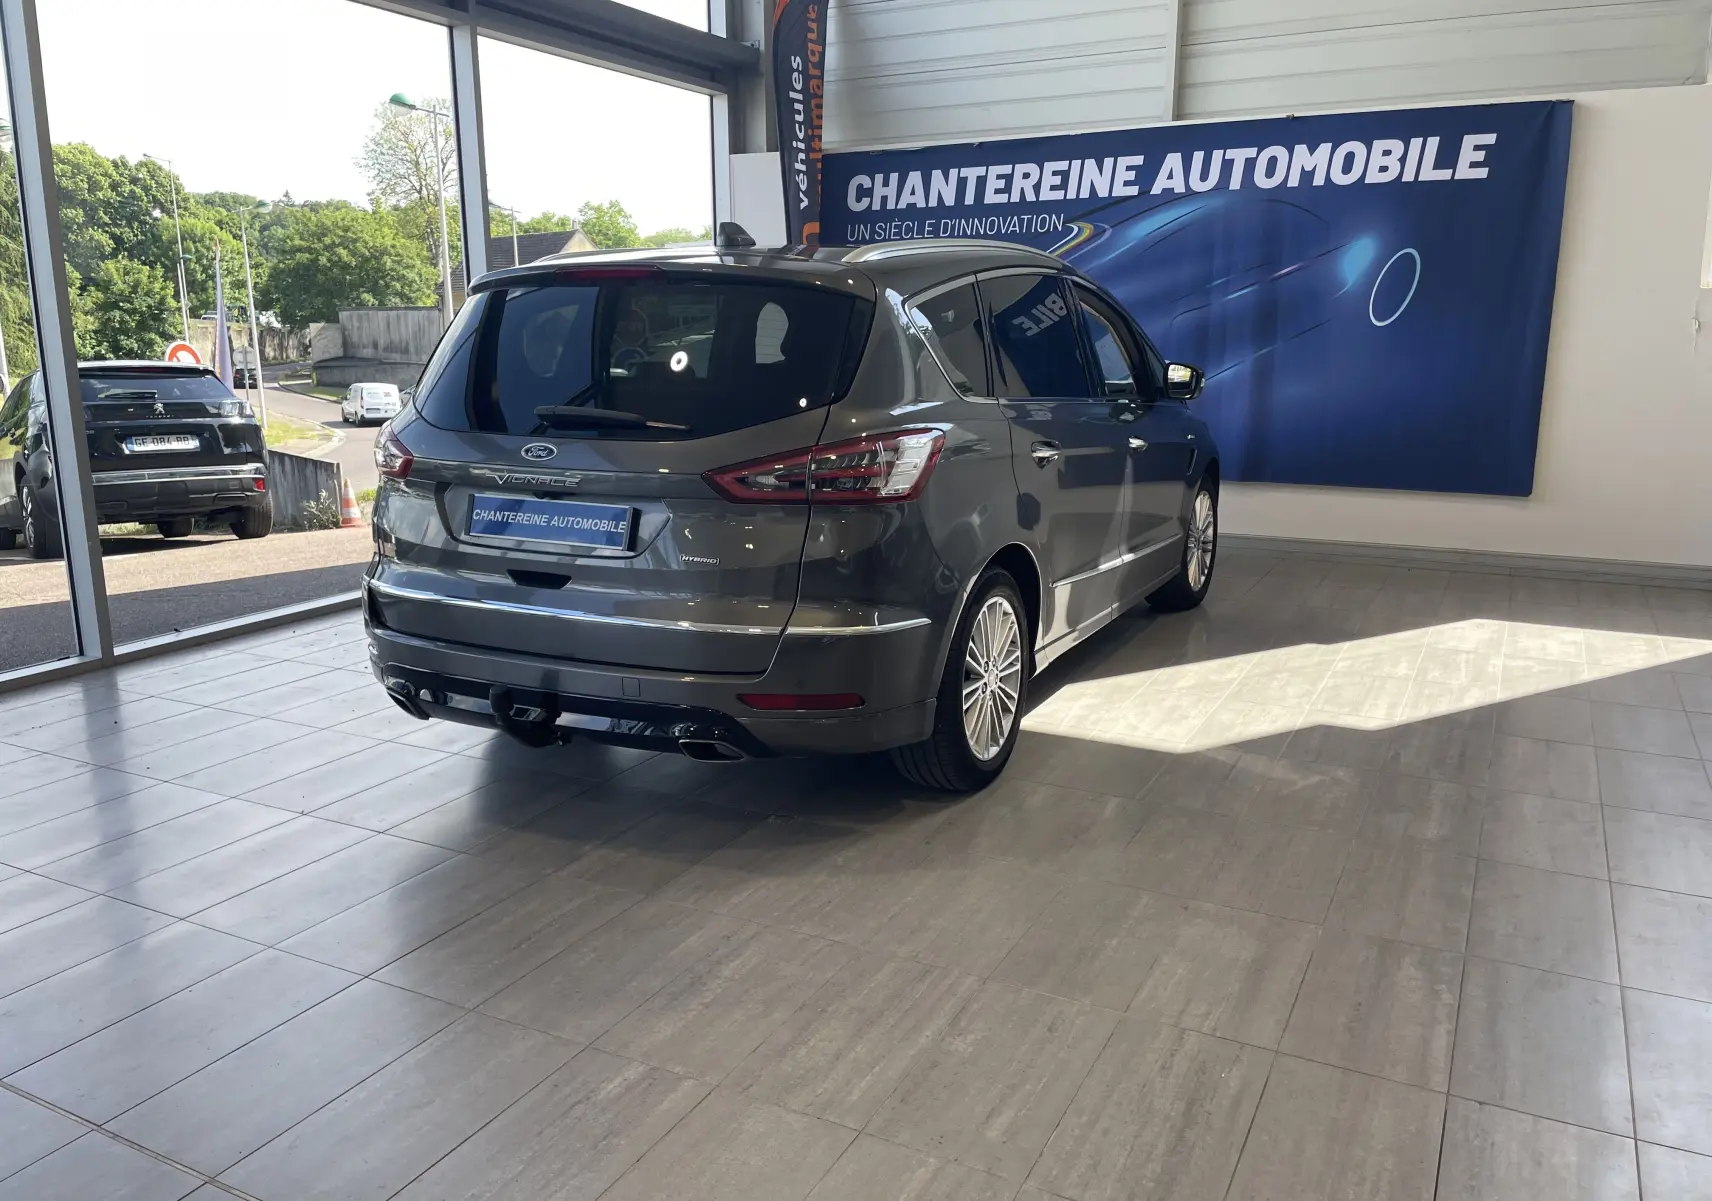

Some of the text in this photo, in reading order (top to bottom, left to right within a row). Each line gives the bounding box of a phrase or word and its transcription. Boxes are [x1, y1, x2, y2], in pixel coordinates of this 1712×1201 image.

[789, 55, 809, 210] véhicules
[847, 133, 1497, 212] CHANTEREINE AUTOMOBILE
[847, 223, 871, 241] UN
[874, 218, 936, 240] SIÈCLE
[527, 445, 549, 457] Ford
[472, 508, 627, 534] CHANTEREINE AUTOMOBILE
